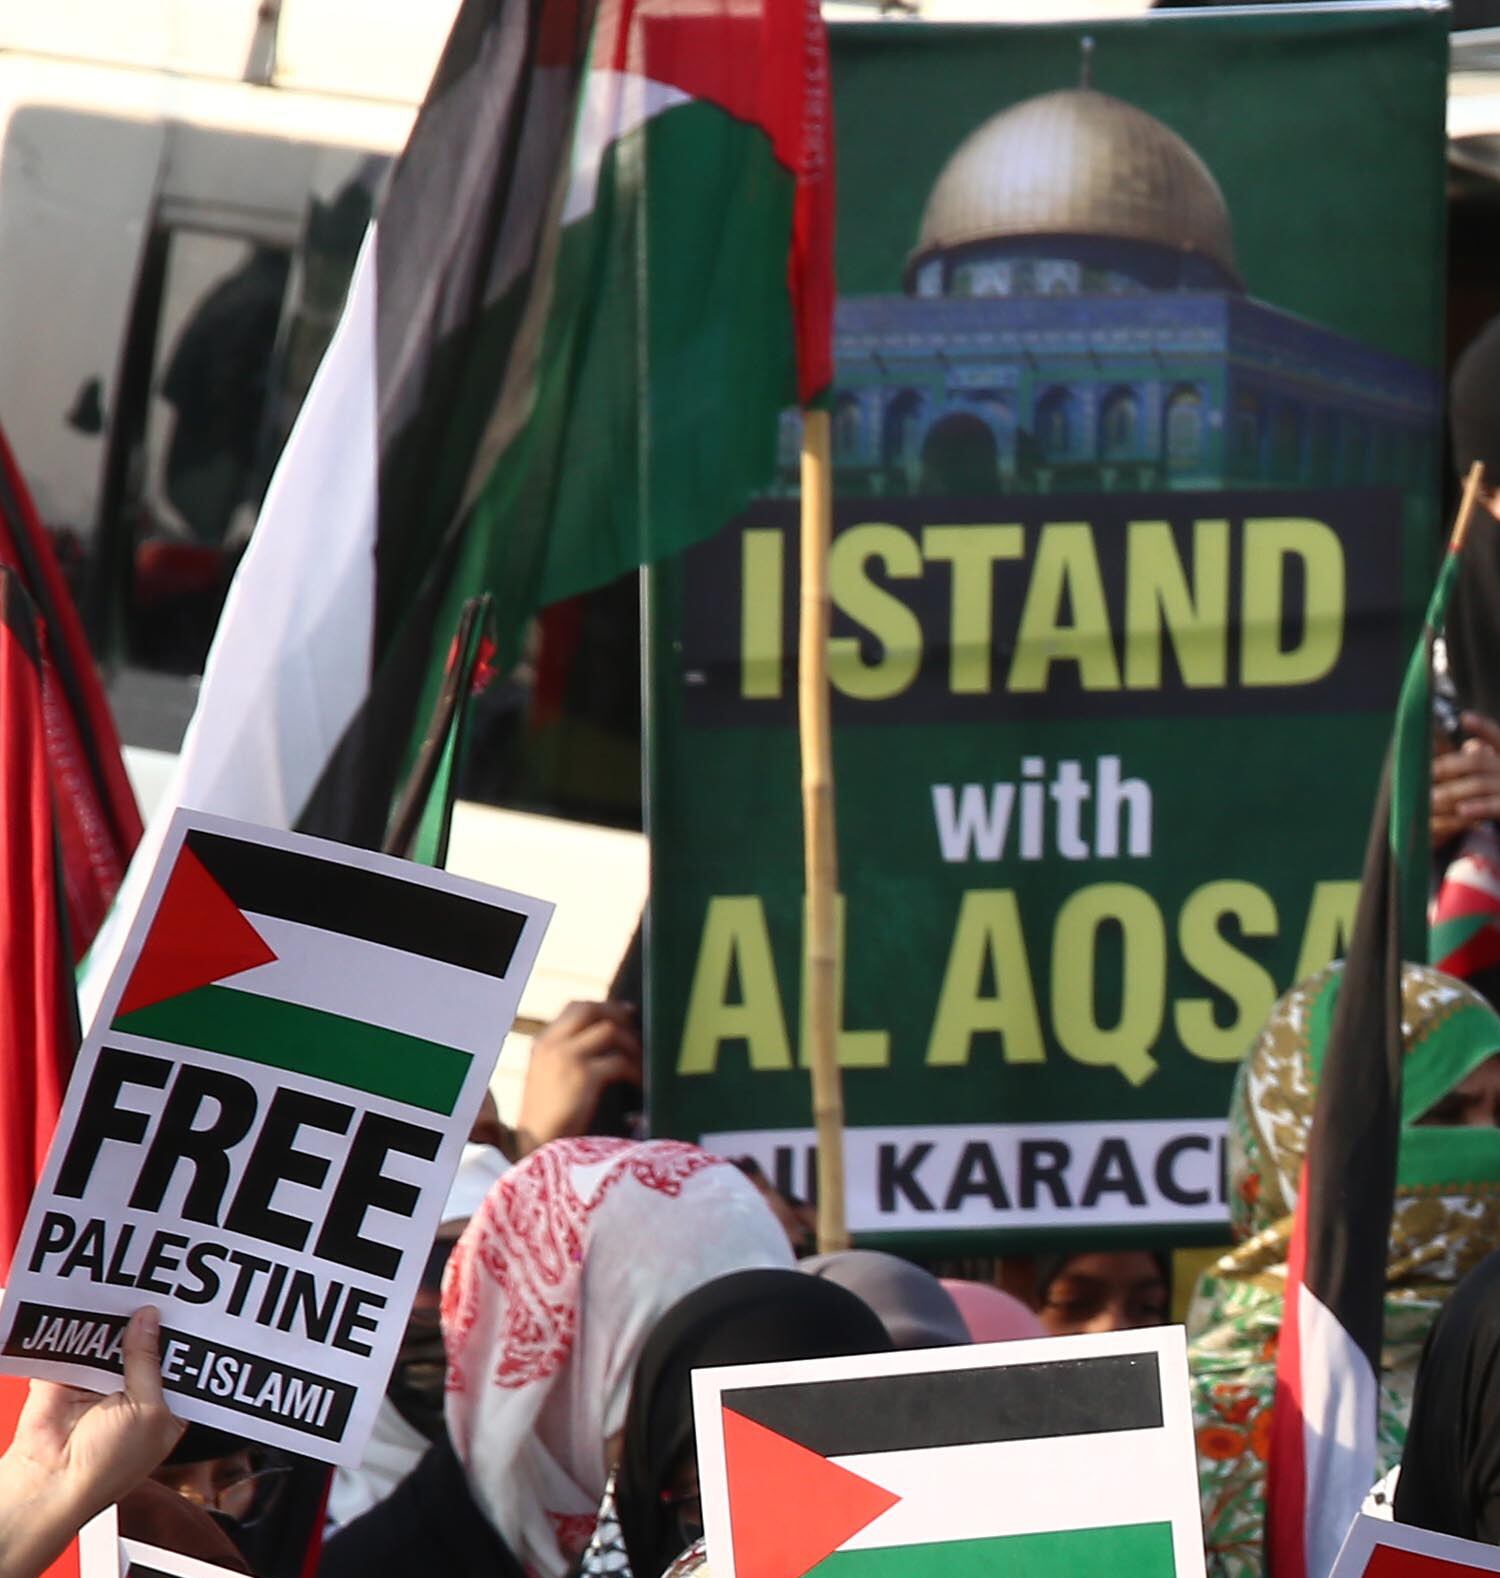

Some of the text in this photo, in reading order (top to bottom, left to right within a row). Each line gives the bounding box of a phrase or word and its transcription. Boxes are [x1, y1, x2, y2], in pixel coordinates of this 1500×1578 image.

[741, 515, 1347, 701] I STAND
[932, 754, 1153, 863] with
[676, 893, 891, 1077] AL
[52, 1045, 445, 1281] FREE
[878, 1136, 1231, 1219] KARAC
[27, 1211, 388, 1358] PALESTINE
[22, 1314, 336, 1428] JAMAAE-ISLAMI
